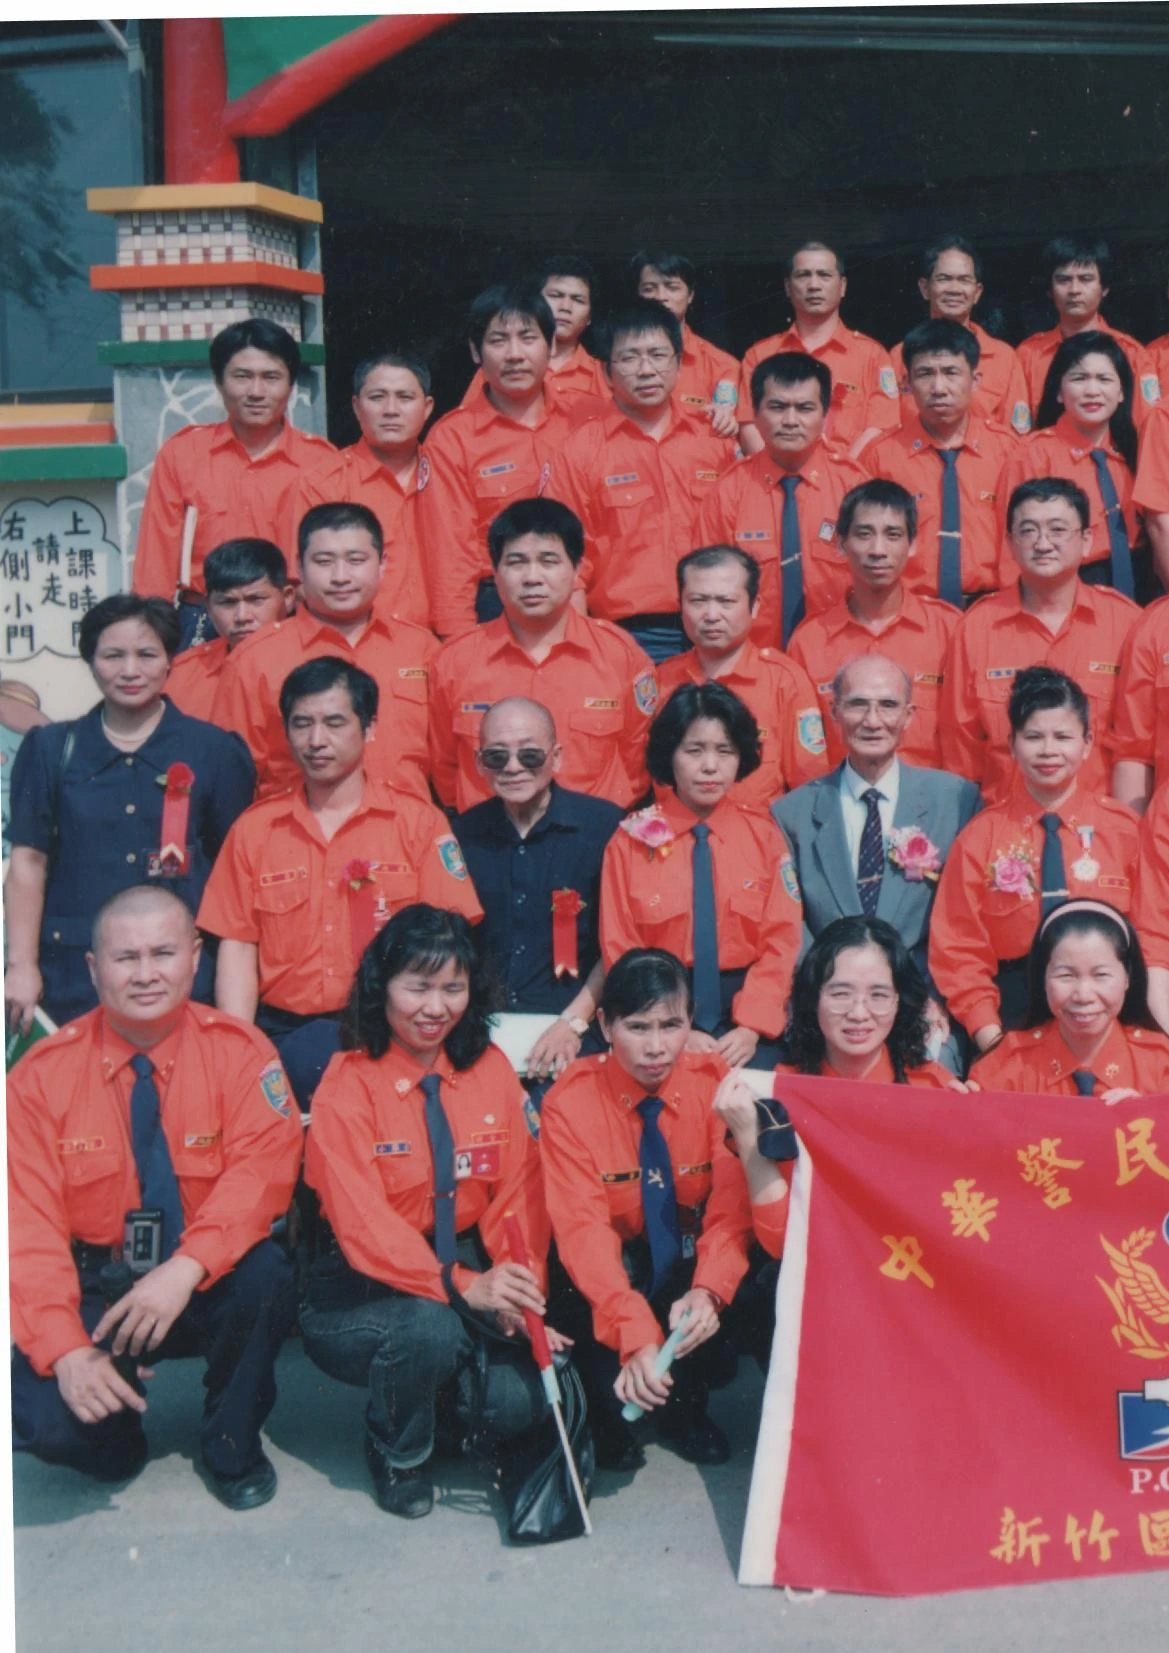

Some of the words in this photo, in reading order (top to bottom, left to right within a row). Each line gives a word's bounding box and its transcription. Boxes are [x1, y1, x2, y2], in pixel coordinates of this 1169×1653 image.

[0, 510, 35, 655] 右側小門
[32, 533, 66, 606] 請走
